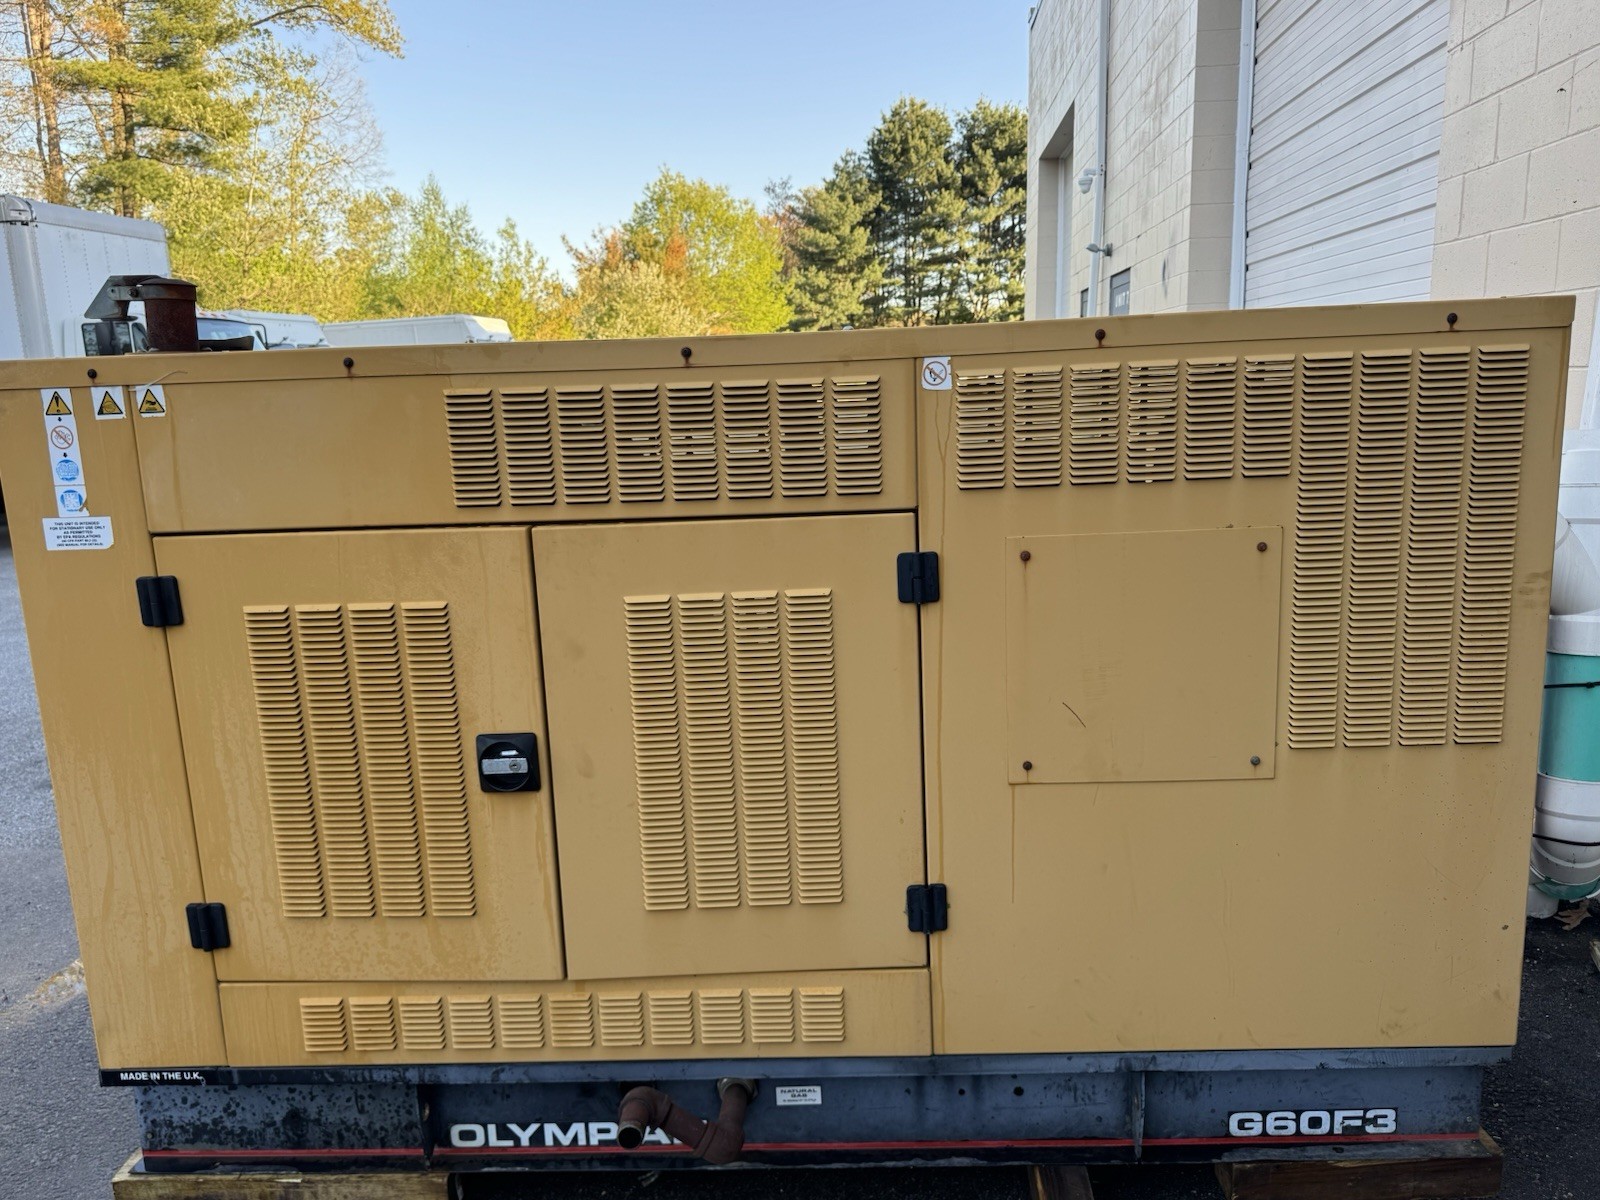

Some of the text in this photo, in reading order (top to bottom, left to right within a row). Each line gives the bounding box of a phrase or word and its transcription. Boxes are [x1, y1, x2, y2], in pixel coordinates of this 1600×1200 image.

[120, 1072, 149, 1080] MADE
[150, 1072, 160, 1080] IN
[162, 1072, 182, 1080] THE
[450, 1120, 707, 1148] OLYMPA
[1228, 1108, 1397, 1137] G60F3
